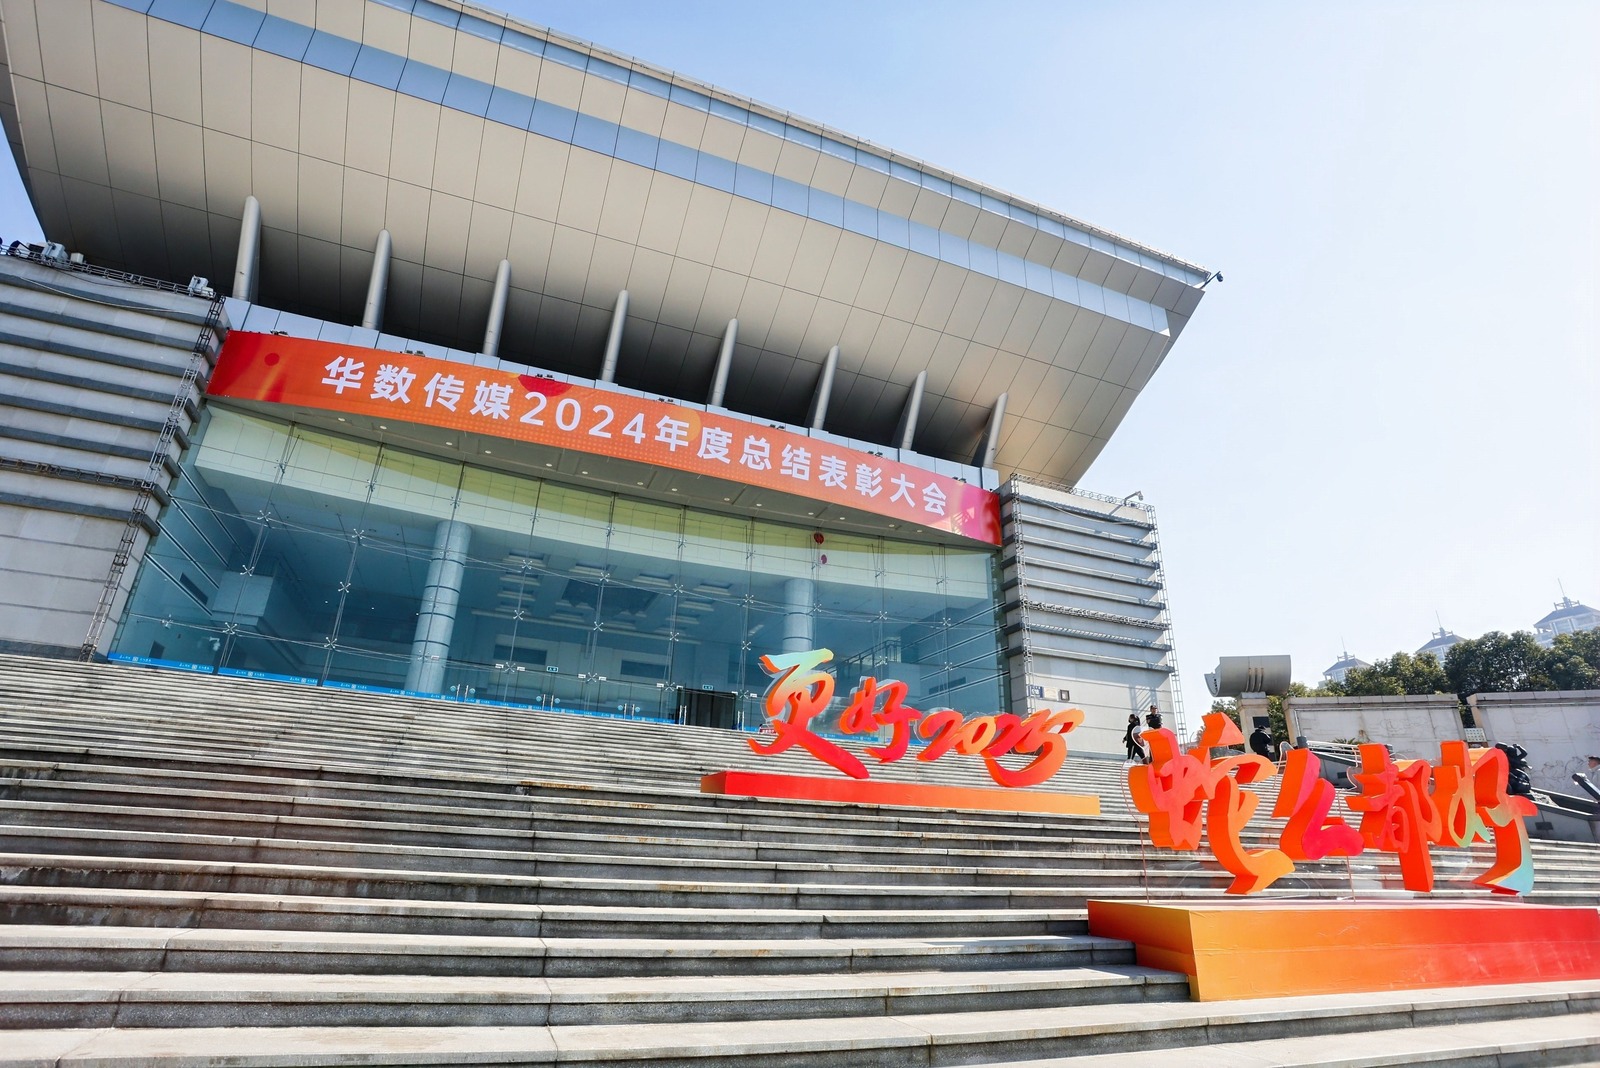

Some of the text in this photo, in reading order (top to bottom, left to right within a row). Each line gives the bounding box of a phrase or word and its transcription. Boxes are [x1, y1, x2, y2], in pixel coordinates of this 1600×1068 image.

[322, 355, 948, 515] 华数传媒2024年度总结表彰大会
[1128, 713, 1537, 896] 蛇么都好
